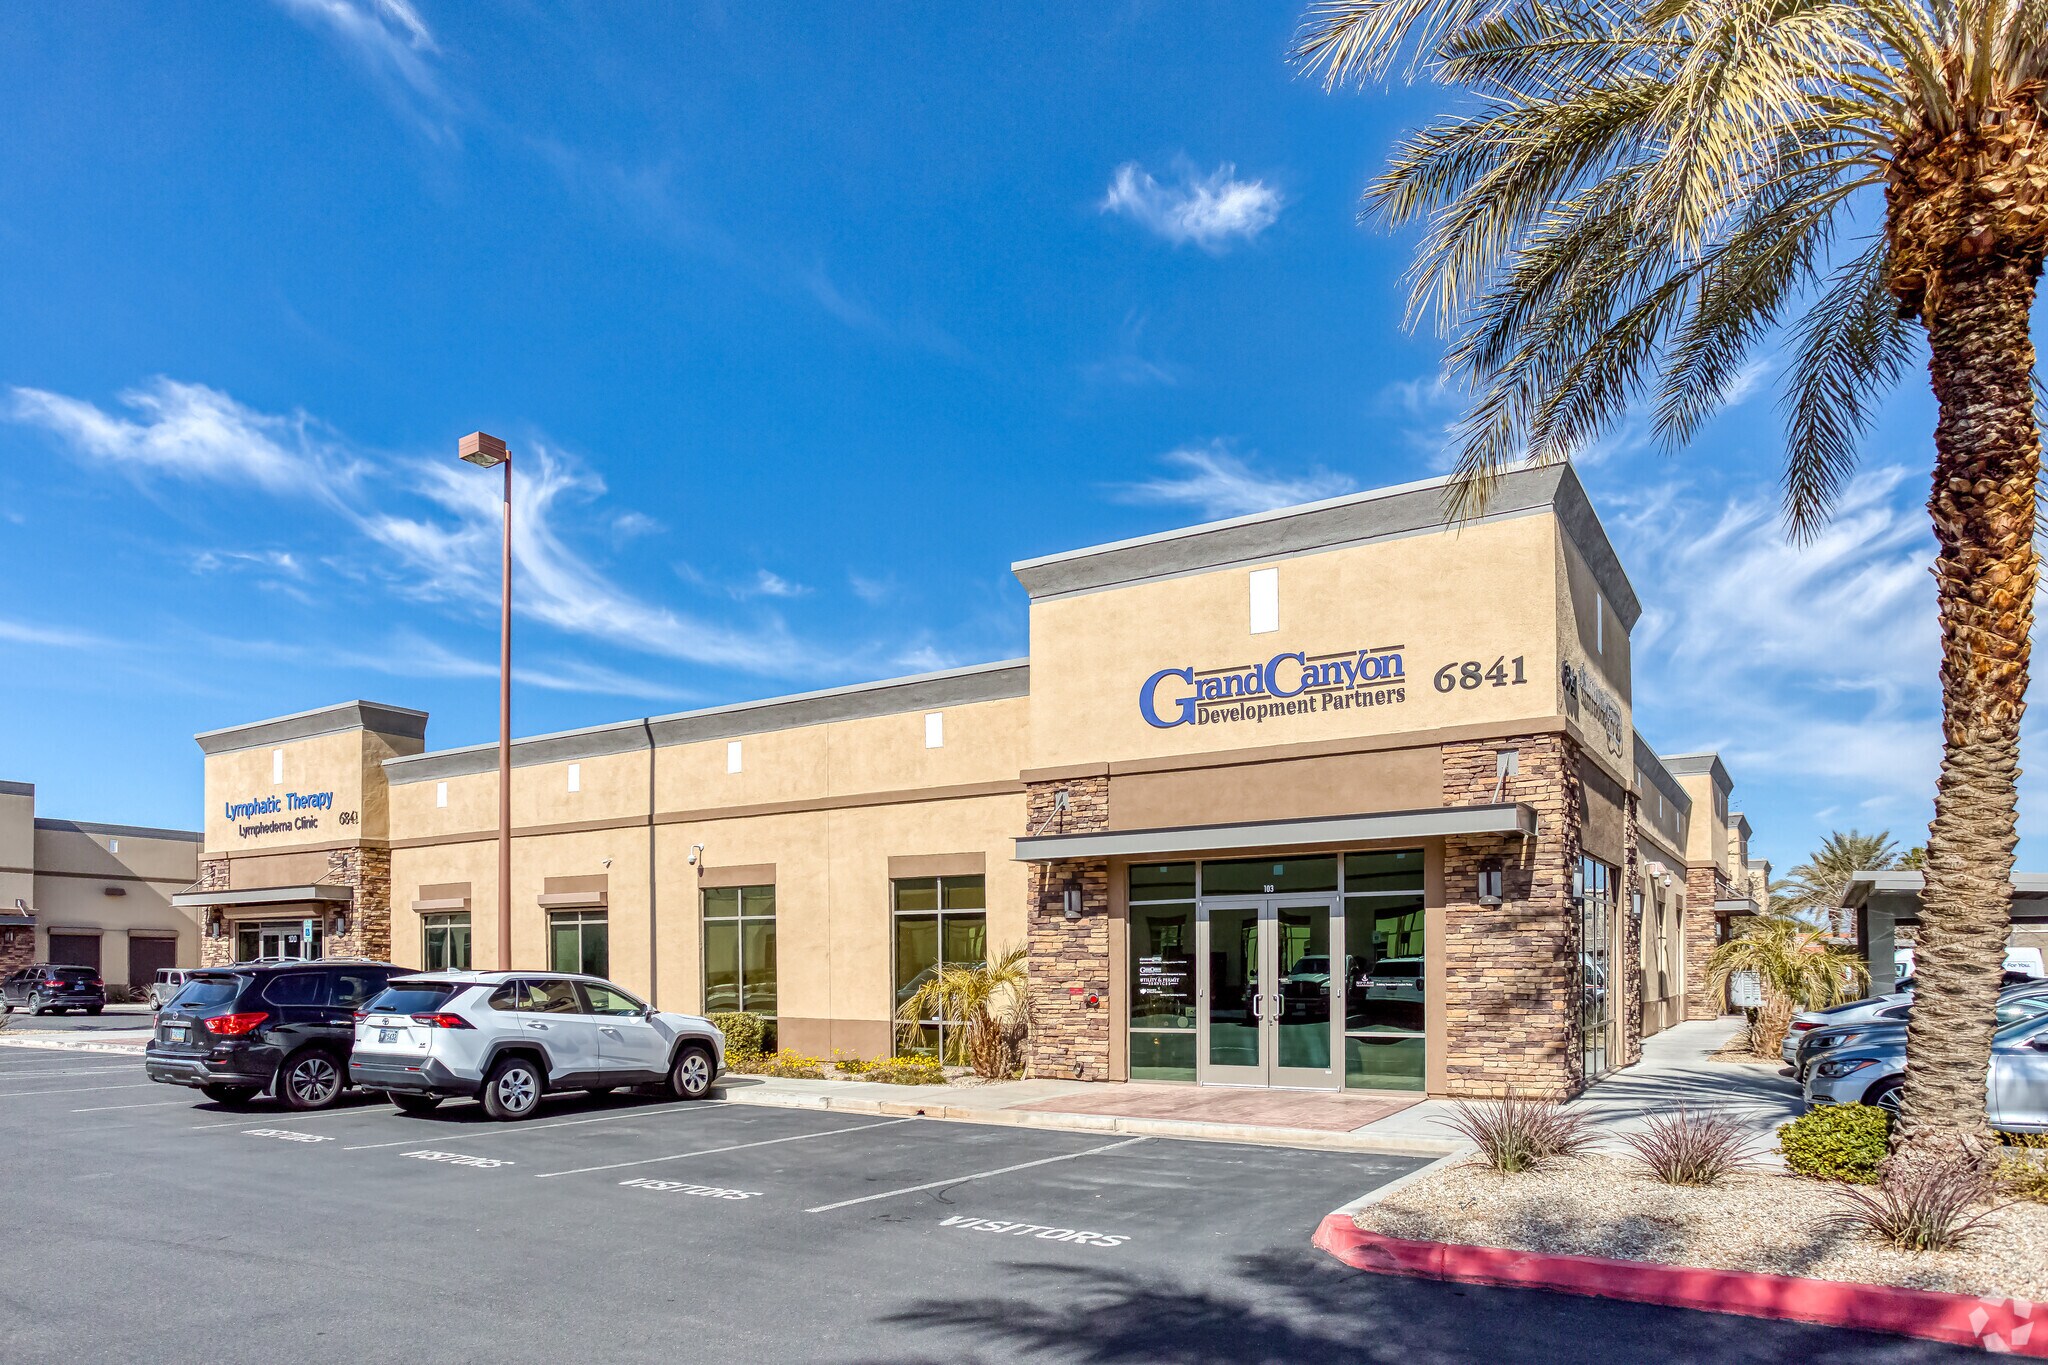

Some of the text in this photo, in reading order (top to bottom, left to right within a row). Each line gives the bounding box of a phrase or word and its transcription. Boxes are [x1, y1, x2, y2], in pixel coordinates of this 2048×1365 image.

[1433, 655, 1528, 694] 6841
[1197, 687, 1406, 726] Development Partners
[225, 791, 334, 822] Lymphatic Therapy
[338, 810, 360, 826] 6841
[239, 815, 319, 839] Lymphedema Clinic
[1263, 884, 1275, 893] 103
[240, 1128, 336, 1143] VISITORS
[398, 1150, 515, 1168] VISITORS
[618, 1178, 764, 1200] VISITORS
[938, 1215, 1132, 1247] VISITORS
